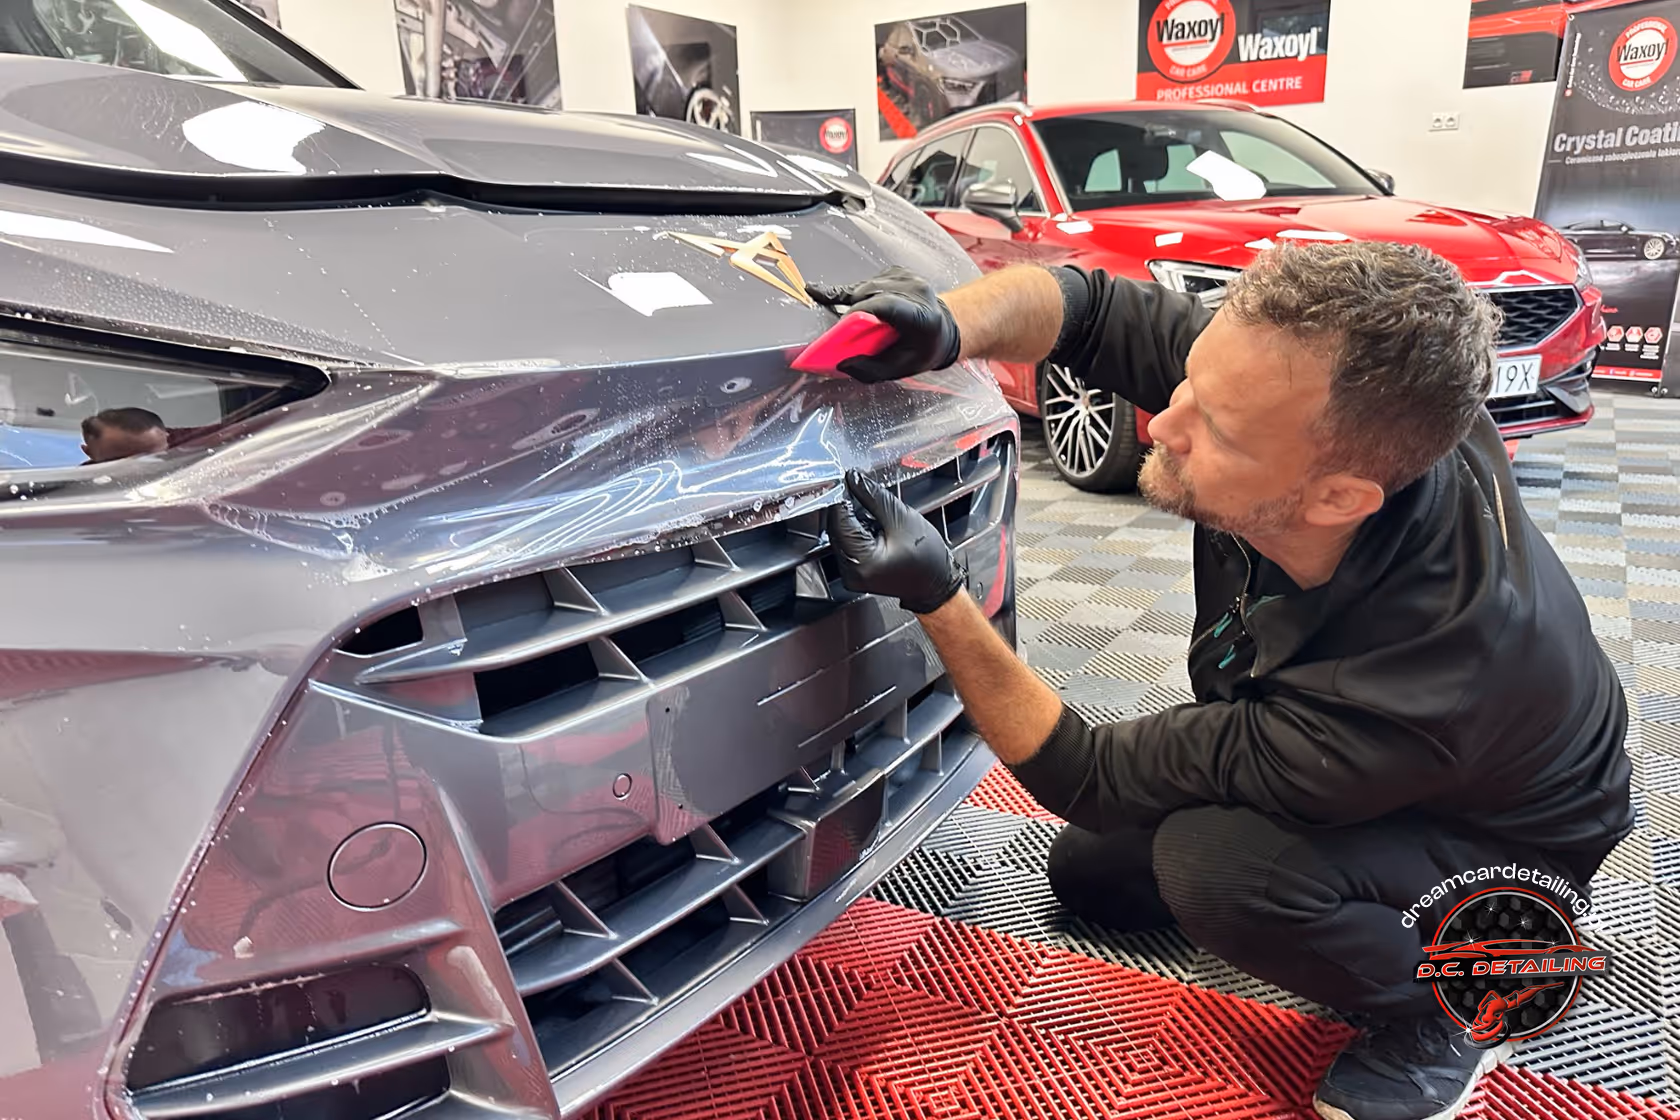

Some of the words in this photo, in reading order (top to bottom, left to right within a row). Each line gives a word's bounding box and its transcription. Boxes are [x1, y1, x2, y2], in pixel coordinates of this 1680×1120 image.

[1156, 12, 1225, 43] Waxoyl
[1237, 27, 1319, 62] Waxoyl
[1617, 38, 1669, 62] Waxoyl
[1156, 82, 1249, 101] PROFESSIONAL
[1252, 76, 1303, 93] CENTRE
[1553, 128, 1623, 155] Crystal
[1625, 121, 1680, 146] Coati
